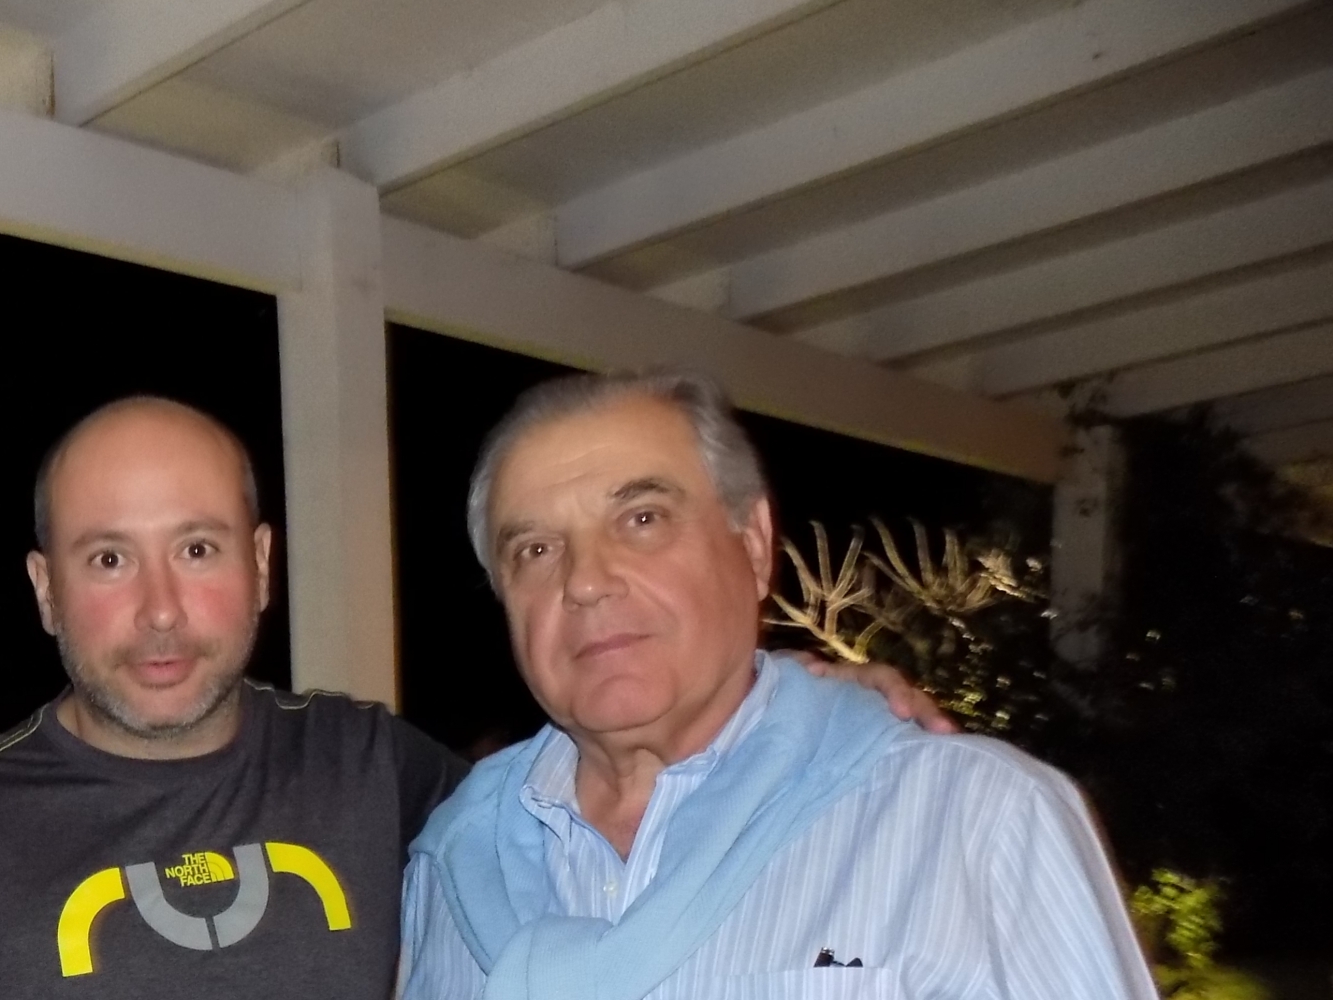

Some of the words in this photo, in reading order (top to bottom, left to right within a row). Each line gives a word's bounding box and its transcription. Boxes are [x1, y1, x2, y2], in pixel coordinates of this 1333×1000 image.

[182, 853, 205, 865] THE
[165, 863, 209, 879] NORTH
[180, 873, 212, 887] FACE
